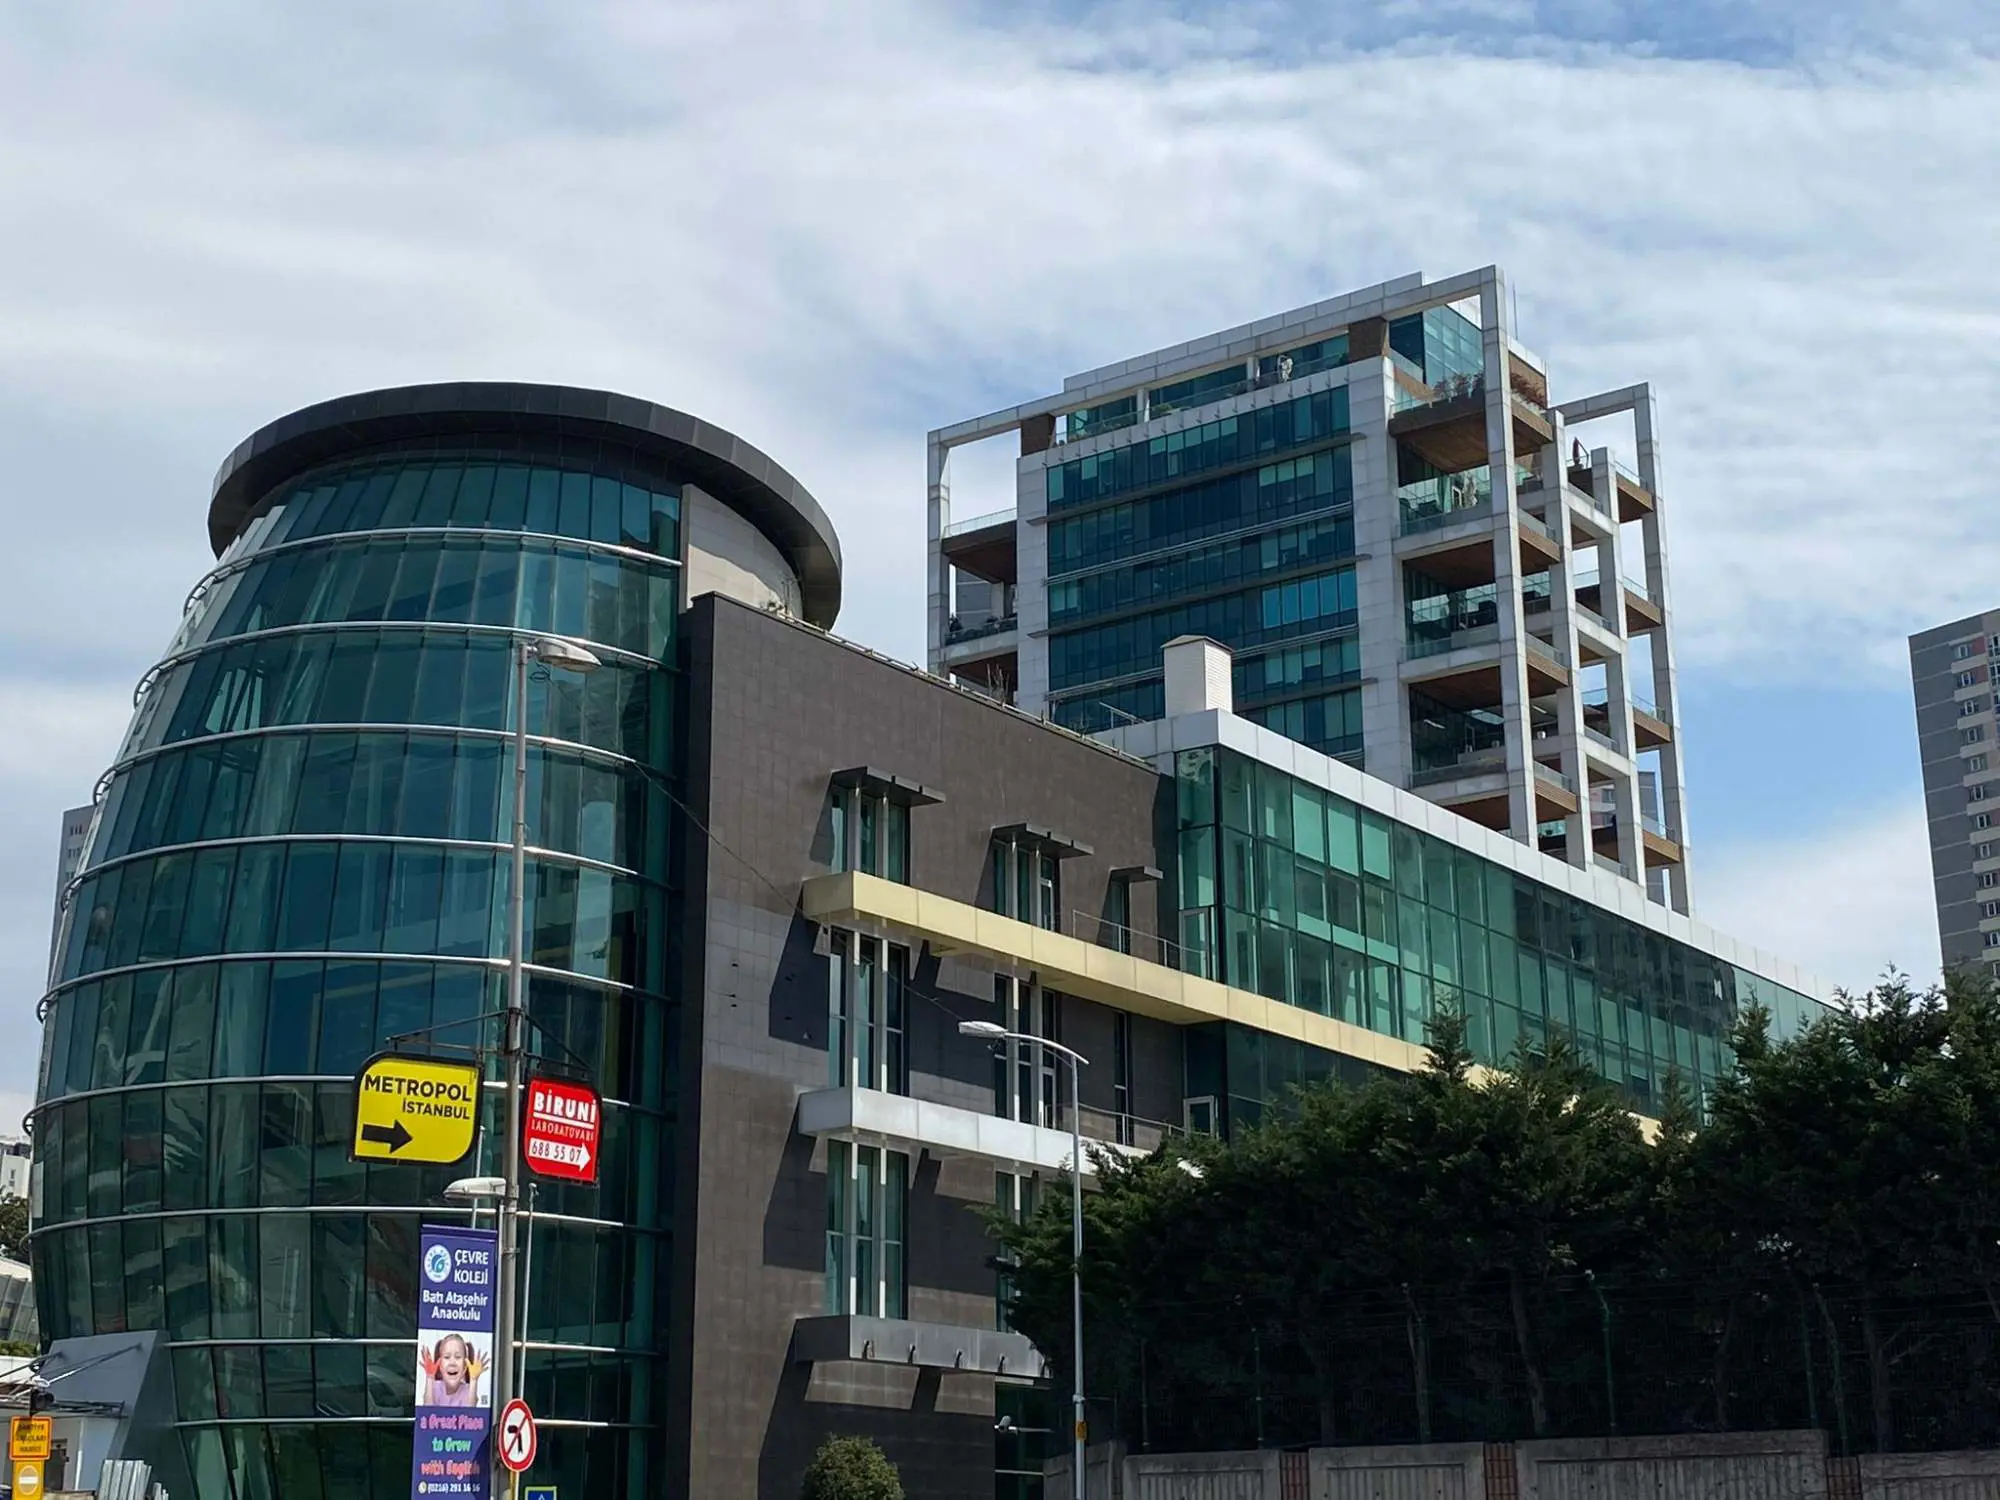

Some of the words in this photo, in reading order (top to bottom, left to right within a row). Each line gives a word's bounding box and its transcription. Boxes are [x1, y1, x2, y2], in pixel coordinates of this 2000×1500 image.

[364, 1074, 471, 1102] METROPOL
[402, 1097, 470, 1119] İSTANBUL
[533, 1088, 597, 1123] BİRUNİ
[531, 1119, 594, 1142] LABORATUVARI
[531, 1141, 550, 1157] 688
[553, 1145, 565, 1160] 55
[569, 1148, 582, 1162] 07
[454, 1249, 489, 1266] ÇEVRE
[454, 1268, 489, 1284] KOLEJİ
[422, 1289, 444, 1304] Batı
[445, 1291, 488, 1308] Ataşehir
[431, 1305, 481, 1321] Anaokulu
[420, 1416, 427, 1429] a
[428, 1413, 457, 1430] Great
[458, 1414, 484, 1430] Place
[431, 1436, 443, 1452] to
[445, 1437, 472, 1452] Grow
[421, 1460, 444, 1475] with
[428, 1482, 449, 1494] (0216)
[449, 1482, 461, 1492] 291
[463, 1482, 471, 1492] 16
